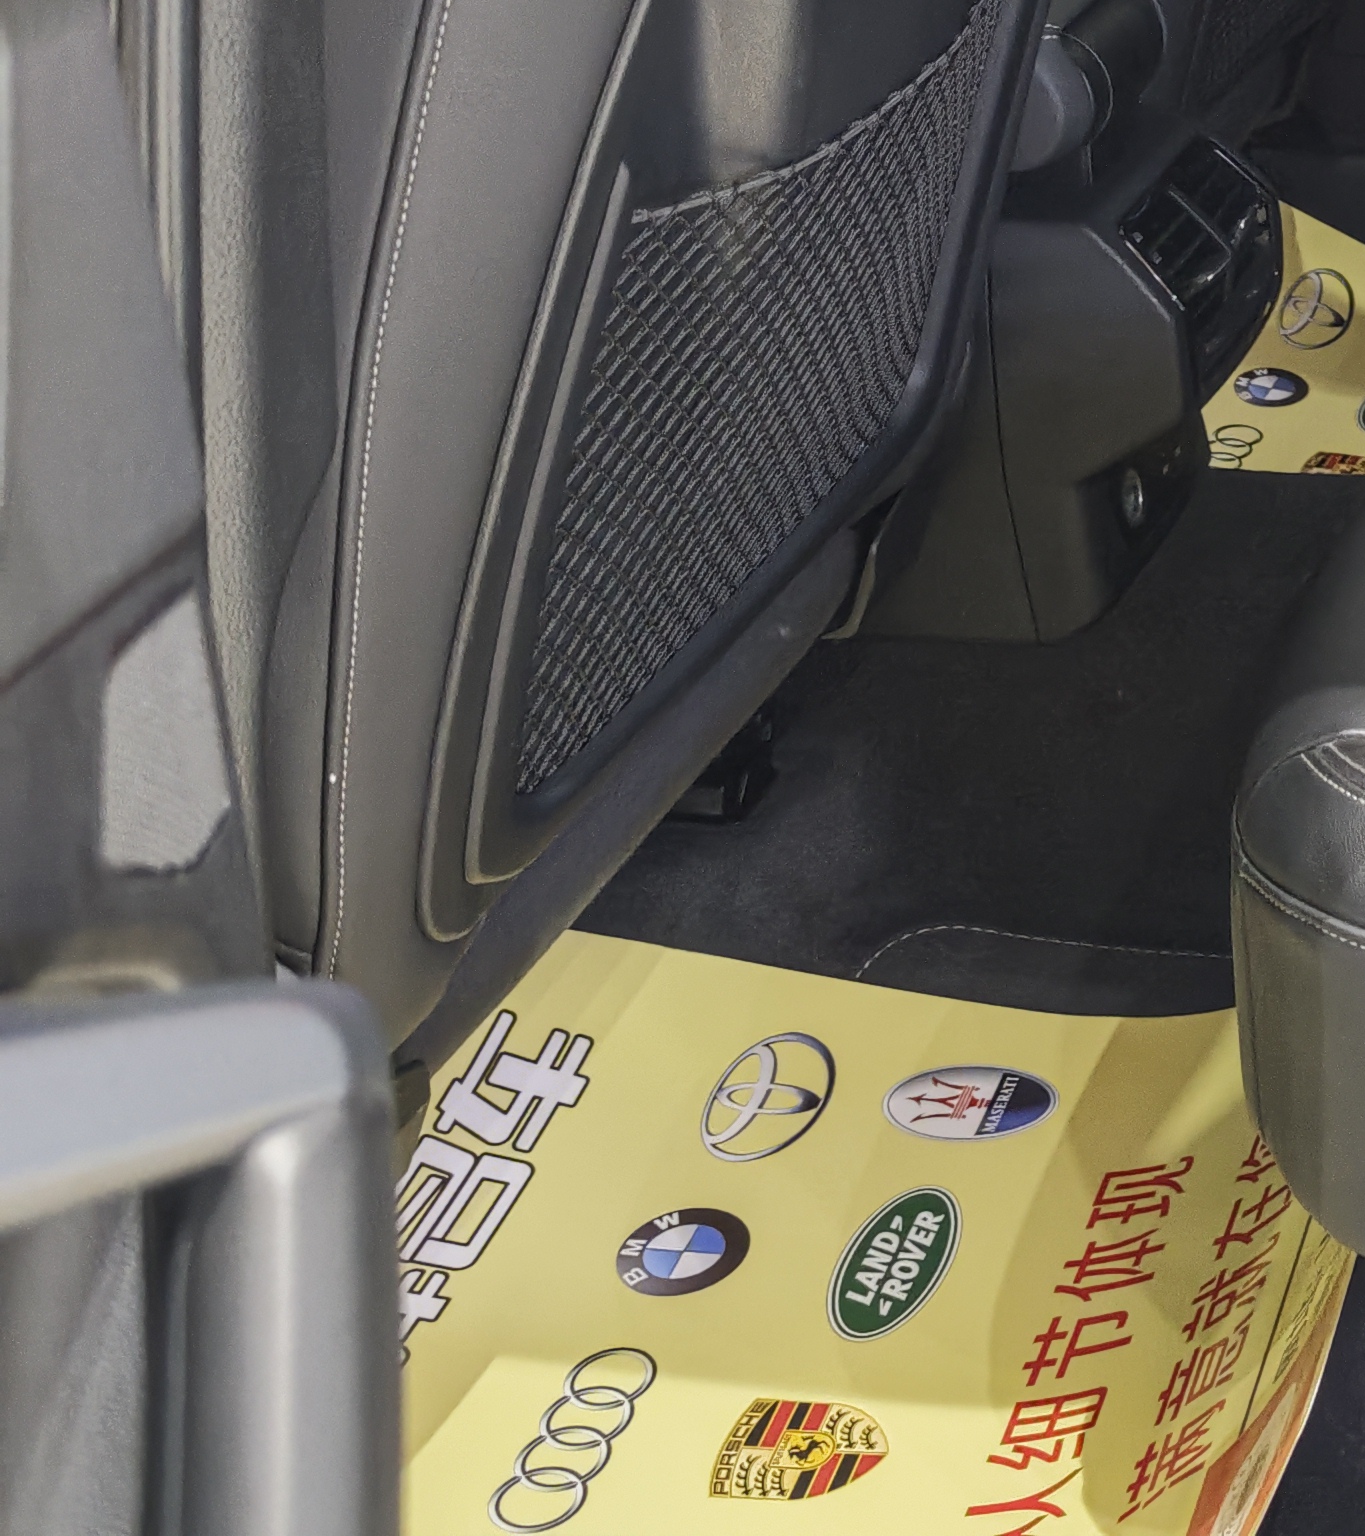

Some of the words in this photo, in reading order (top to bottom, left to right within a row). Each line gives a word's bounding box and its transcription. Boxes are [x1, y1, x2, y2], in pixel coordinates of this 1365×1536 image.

[981, 1076, 1020, 1133] MASERATI
[619, 1211, 680, 1287] BMW
[845, 1231, 901, 1307] LAND
[880, 1210, 945, 1302] ROVER
[713, 1400, 773, 1496] PORSCHE
